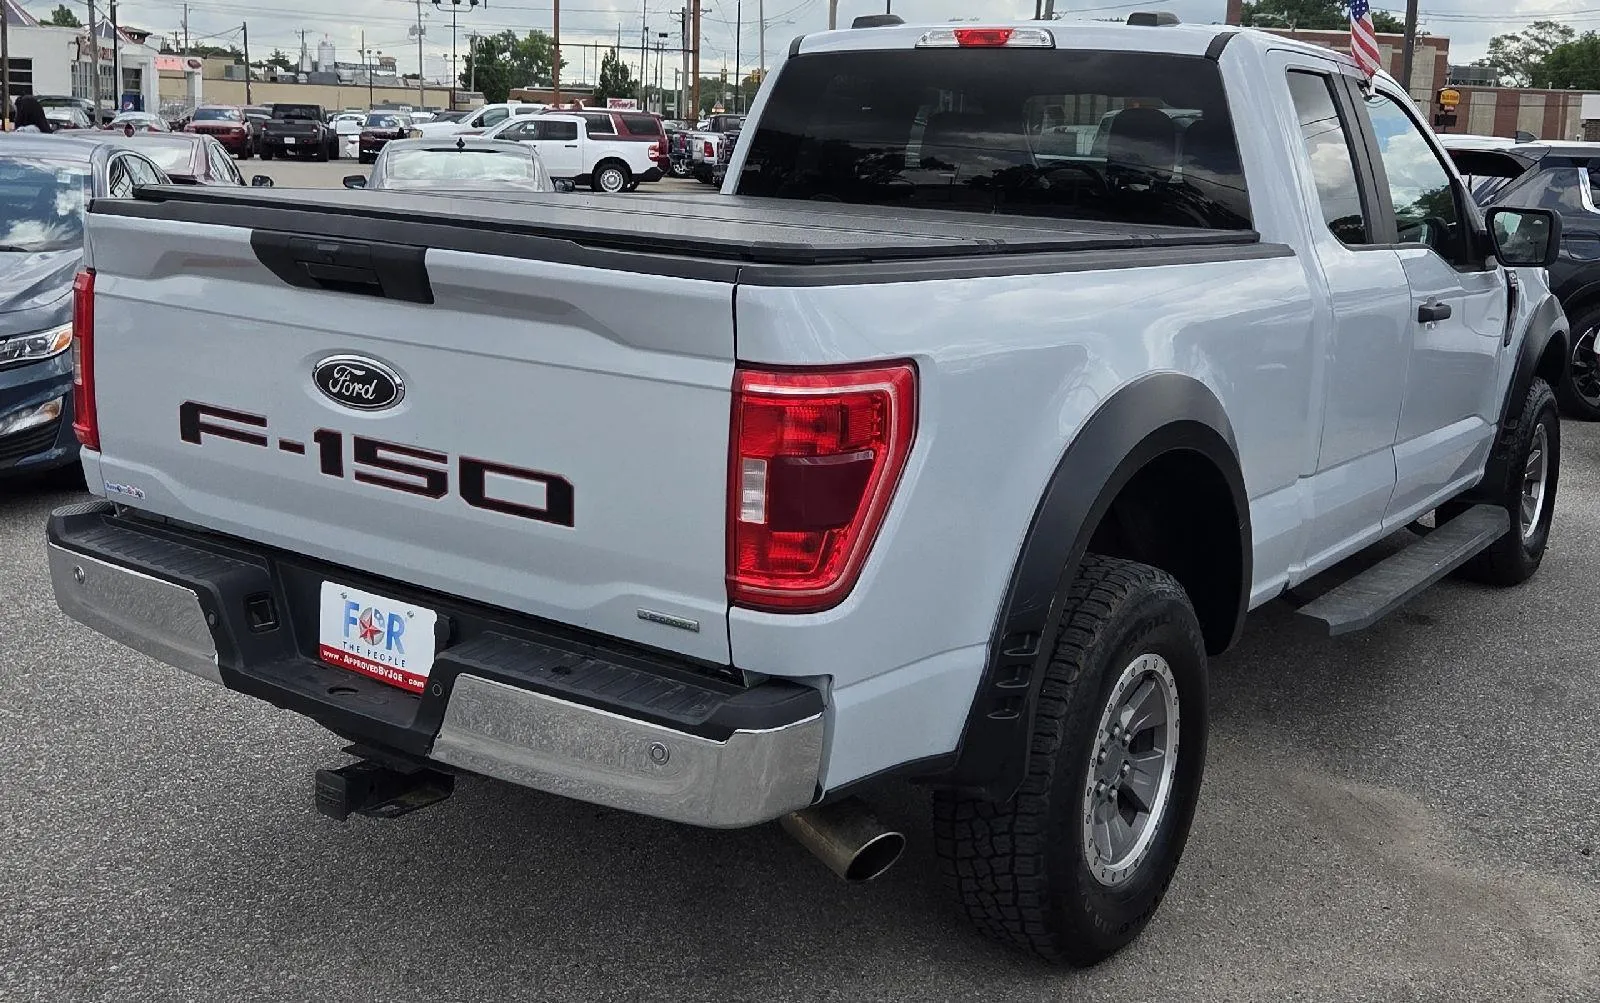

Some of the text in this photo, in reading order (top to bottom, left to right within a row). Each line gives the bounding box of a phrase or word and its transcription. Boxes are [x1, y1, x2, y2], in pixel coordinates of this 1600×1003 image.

[328, 365, 378, 400] Ford
[179, 400, 576, 528] F-150
[343, 600, 405, 654] FOR
[342, 641, 406, 668] THE PEOPLE
